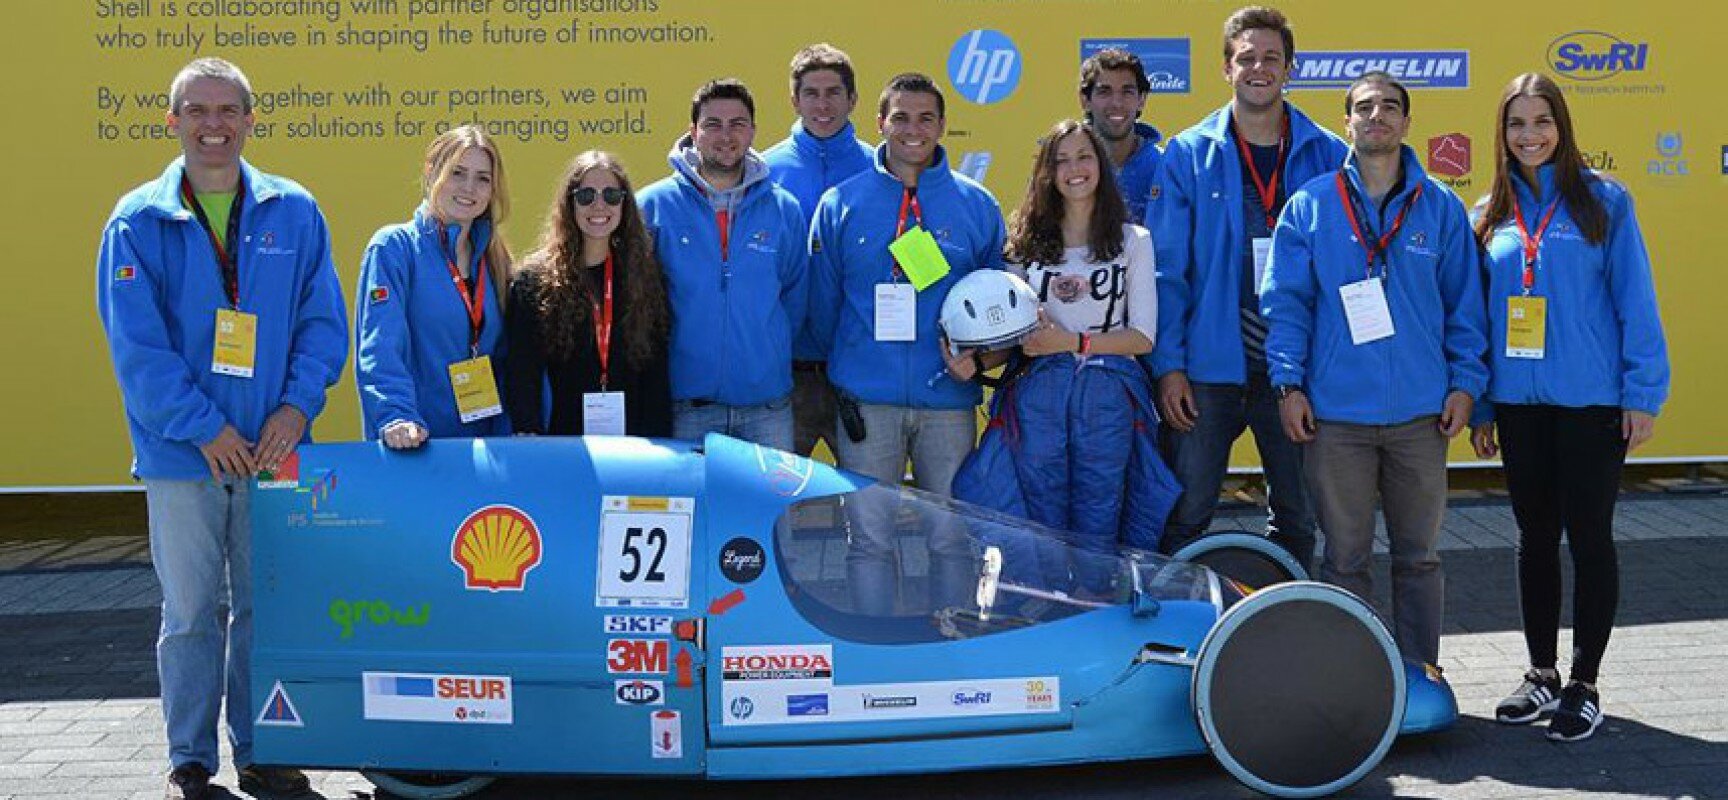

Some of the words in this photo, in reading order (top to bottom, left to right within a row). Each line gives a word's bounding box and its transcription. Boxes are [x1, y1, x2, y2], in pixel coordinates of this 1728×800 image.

[96, 0, 150, 18] Shell
[160, 0, 177, 17] is
[186, 0, 341, 21] collaborating
[350, 0, 398, 16] with
[409, 0, 492, 20] partner
[502, 0, 659, 20] organisations
[96, 23, 147, 48] who
[156, 25, 204, 54] truly
[214, 23, 297, 47] believe
[307, 25, 326, 46] in
[336, 22, 429, 52] shaping
[438, 21, 474, 44] the
[482, 20, 547, 43] future
[556, 19, 579, 43] of
[589, 21, 714, 43] innovation.
[956, 30, 1015, 103] hp
[1299, 58, 1462, 78] MICHELIN
[1554, 43, 1648, 71] SwRI
[98, 86, 126, 116] By
[343, 83, 391, 107] with
[400, 92, 440, 107] our
[449, 86, 550, 113] partners,
[560, 89, 597, 105] we
[604, 83, 648, 105] aim
[98, 119, 119, 140] to
[287, 114, 384, 138] solutions
[394, 112, 426, 136] for
[577, 111, 651, 134] world.
[619, 527, 668, 583] 52
[328, 599, 431, 638] grow
[609, 616, 670, 631] SKF
[608, 640, 668, 672] 3M
[724, 654, 830, 670] HONDA
[438, 677, 507, 700] SEUR
[623, 687, 654, 700] KIP
